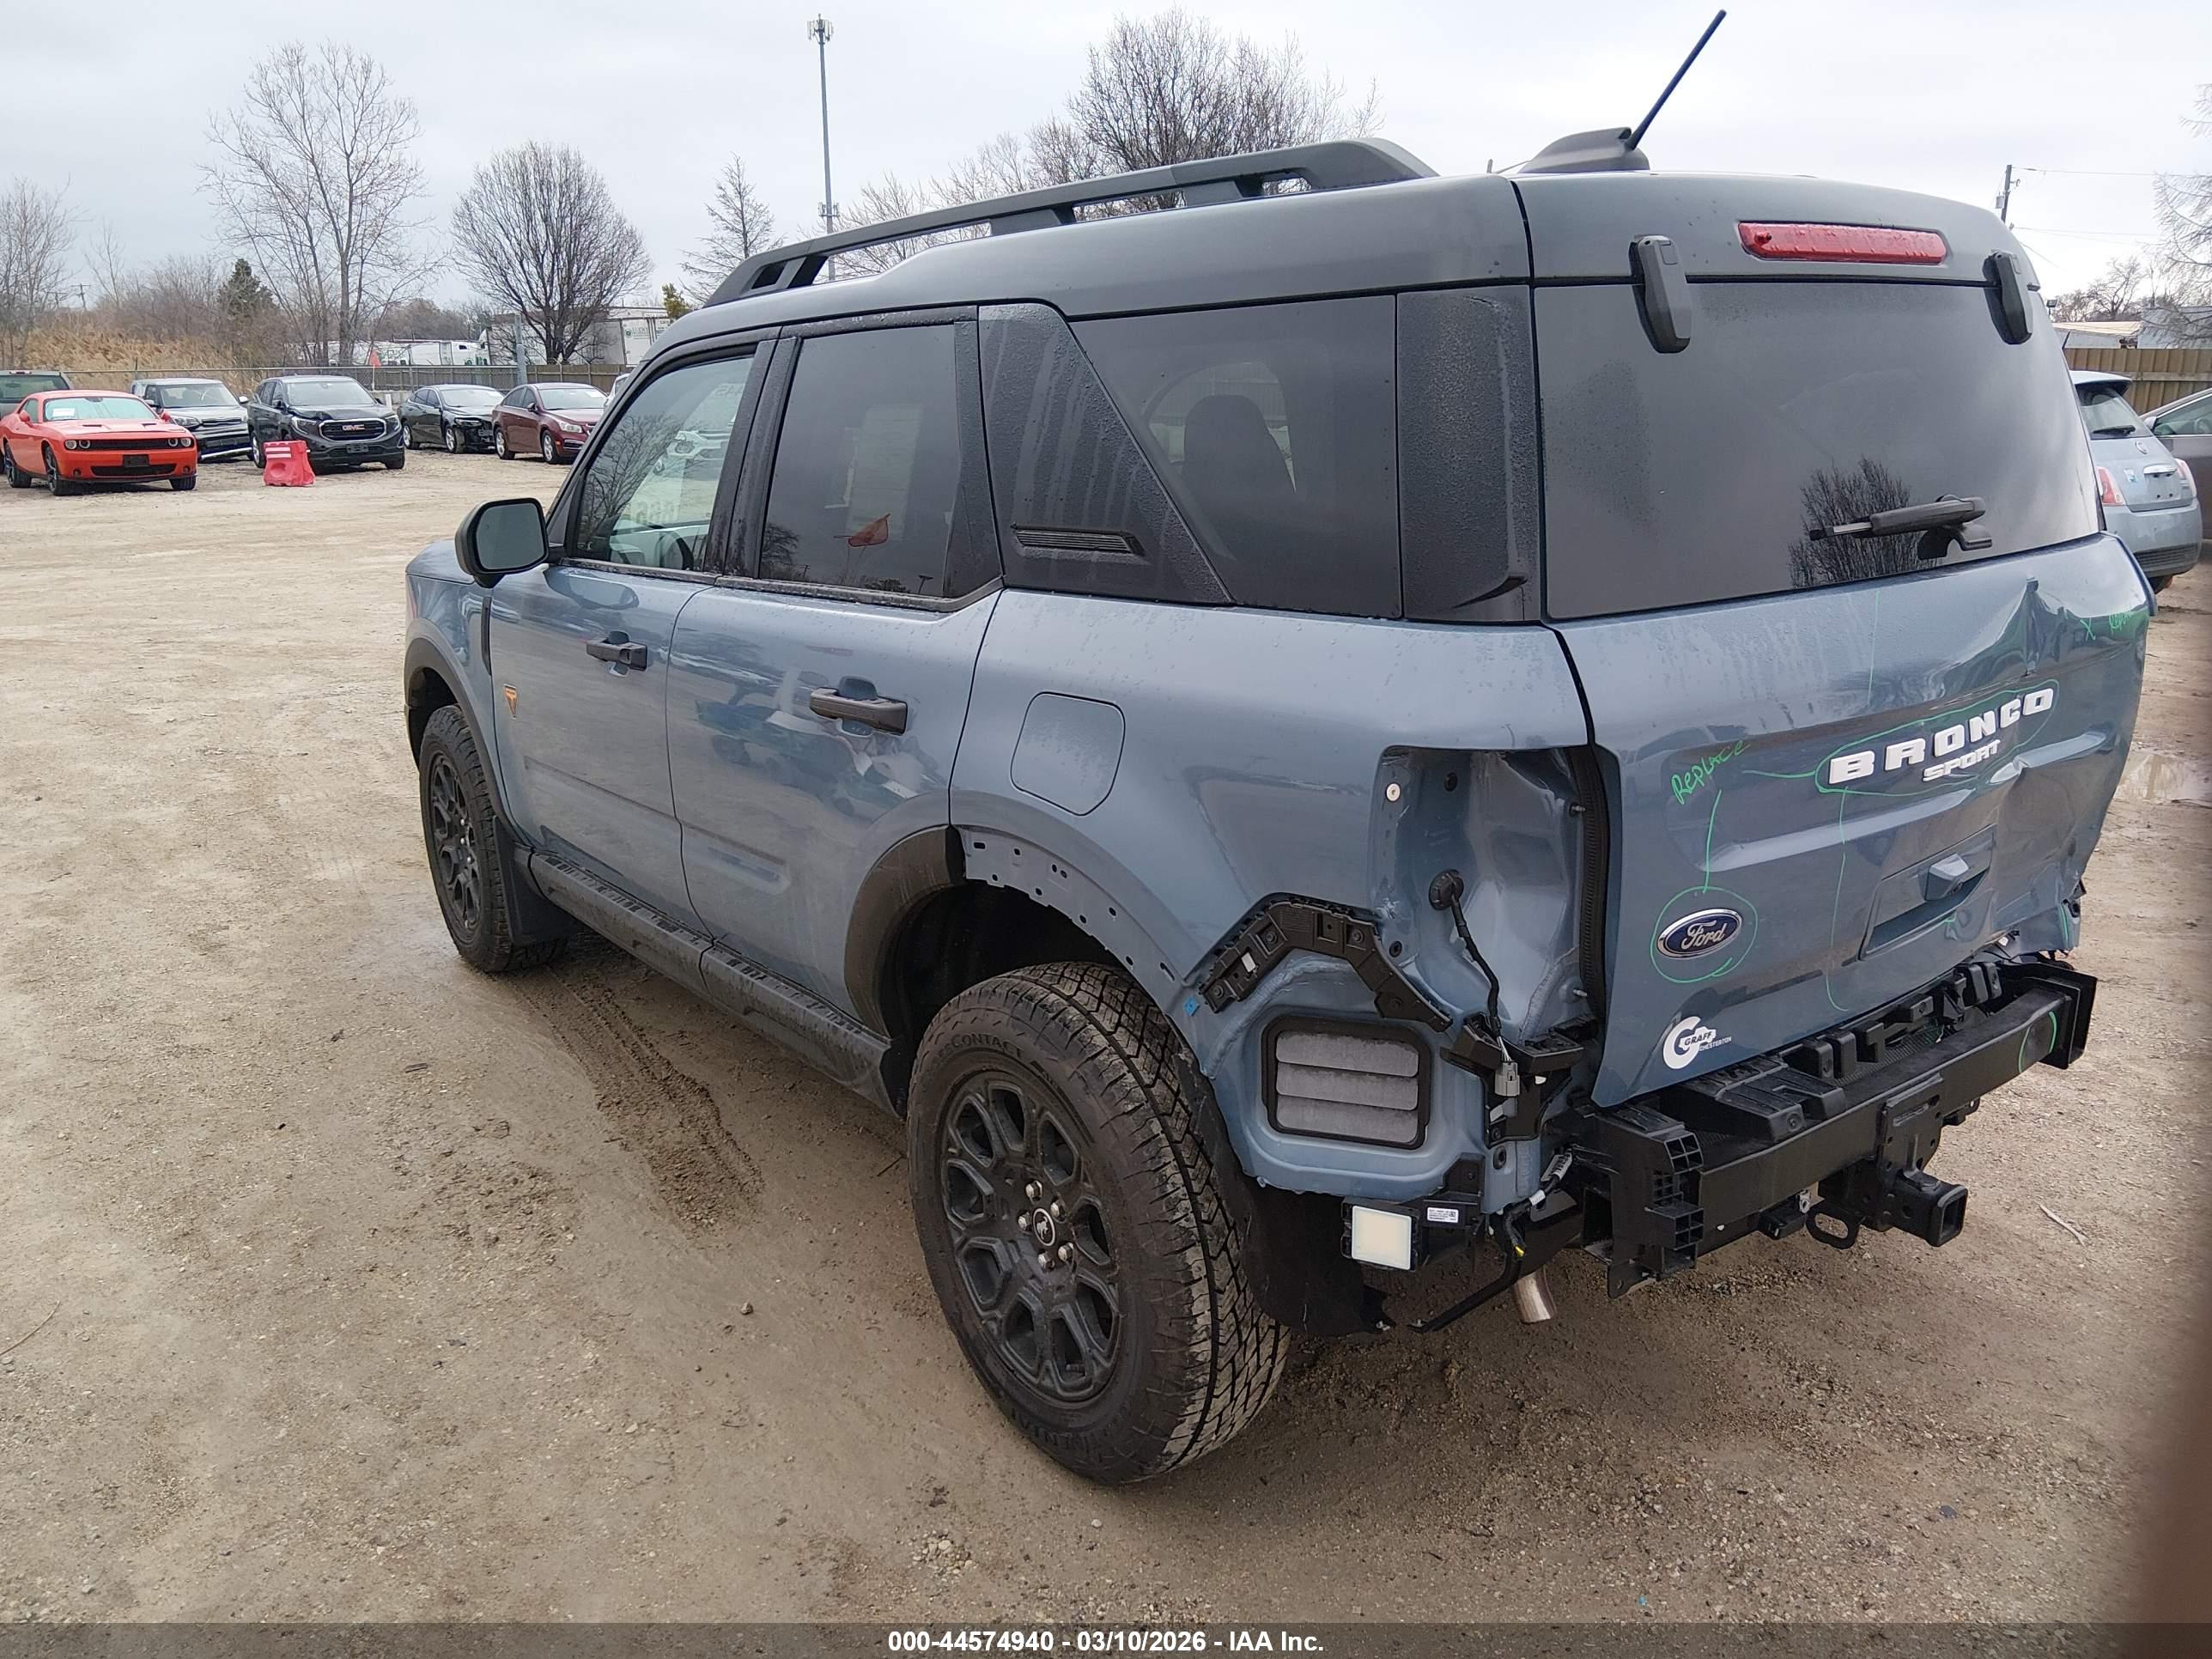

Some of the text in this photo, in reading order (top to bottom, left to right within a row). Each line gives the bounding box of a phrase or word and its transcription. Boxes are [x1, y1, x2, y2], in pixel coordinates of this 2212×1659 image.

[1829, 689, 2054, 784] BRONCO
[1923, 739, 2001, 782] SPORT
[1681, 920, 1728, 950] Ford
[1684, 1031, 1713, 1046] GRAFF
[1699, 1036, 1732, 1052] CHESTERTON
